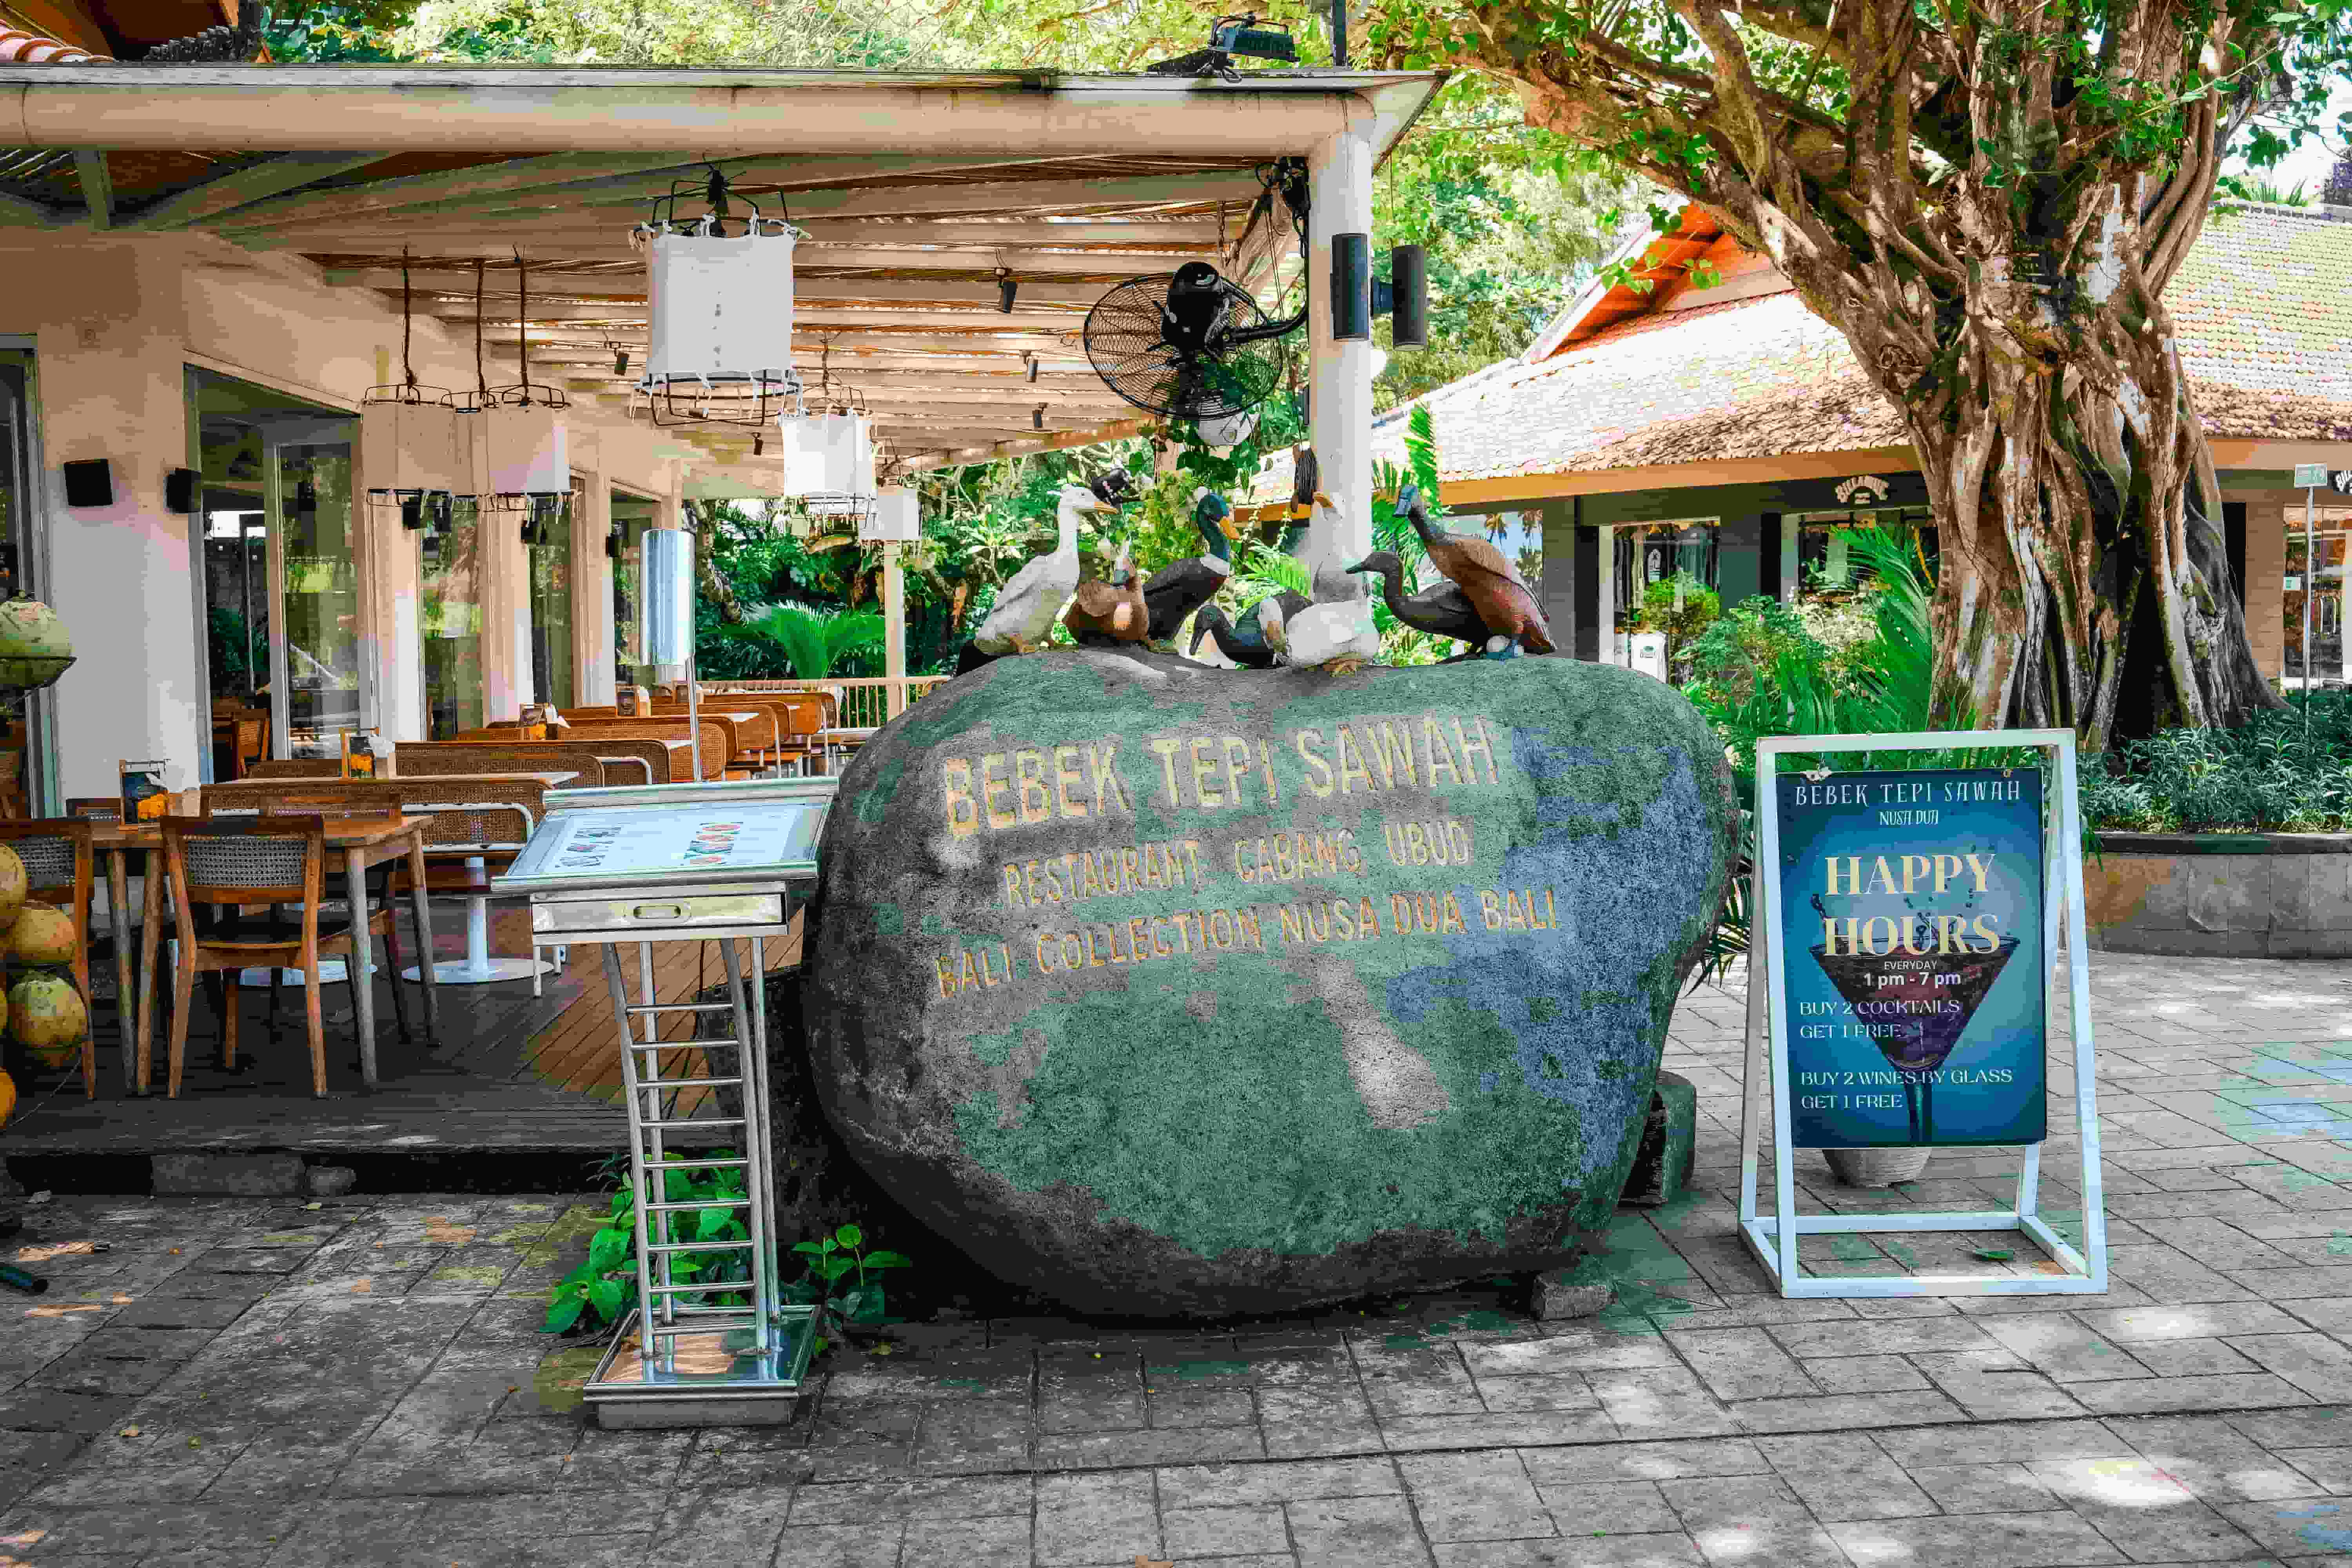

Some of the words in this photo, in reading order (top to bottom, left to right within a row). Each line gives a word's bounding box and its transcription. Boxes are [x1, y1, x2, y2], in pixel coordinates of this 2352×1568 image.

[944, 744, 1129, 840] BEBEK
[1151, 735, 1279, 808] TEPI
[1296, 713, 1500, 797] SAWAH
[1796, 784, 1869, 806] BEBEK
[1880, 782, 1932, 803] TEPI
[1944, 780, 2020, 802] SAWAH
[1879, 809, 1911, 825] NUSA
[1916, 809, 1939, 825] DUA
[1004, 839, 1200, 906] RESTAURANT
[1234, 828, 1362, 883] CABANG
[1384, 820, 1473, 866] UBUD
[1825, 853, 1996, 895] HAPPY
[935, 943, 1013, 998] BALI
[1037, 904, 1262, 973] COLLECTION
[1280, 896, 1381, 944] NUSA
[1392, 890, 1467, 935] DUA
[1480, 889, 1557, 930] BALI
[1823, 913, 2001, 956] HOURS
[1884, 960, 1937, 970] EVERYDAY
[1864, 972, 1872, 986] 1
[1878, 974, 1904, 990] pm
[1919, 972, 1929, 986] 7
[1935, 973, 1961, 989] pm
[1800, 1001, 1837, 1015] BUY
[1843, 1002, 1854, 1014] 2
[1857, 999, 1960, 1014] COCKTAILS
[1800, 1024, 1836, 1038] GET
[1854, 1024, 1902, 1038] FREE
[1800, 1071, 1839, 1085] BUY
[1843, 1071, 1854, 1085] 2
[1857, 1070, 1916, 1085] WINES
[1922, 1070, 1947, 1084] BY
[1951, 1069, 2014, 1083] GLASS
[1801, 1095, 1838, 1110] GET
[1856, 1094, 1904, 1109] FREE
